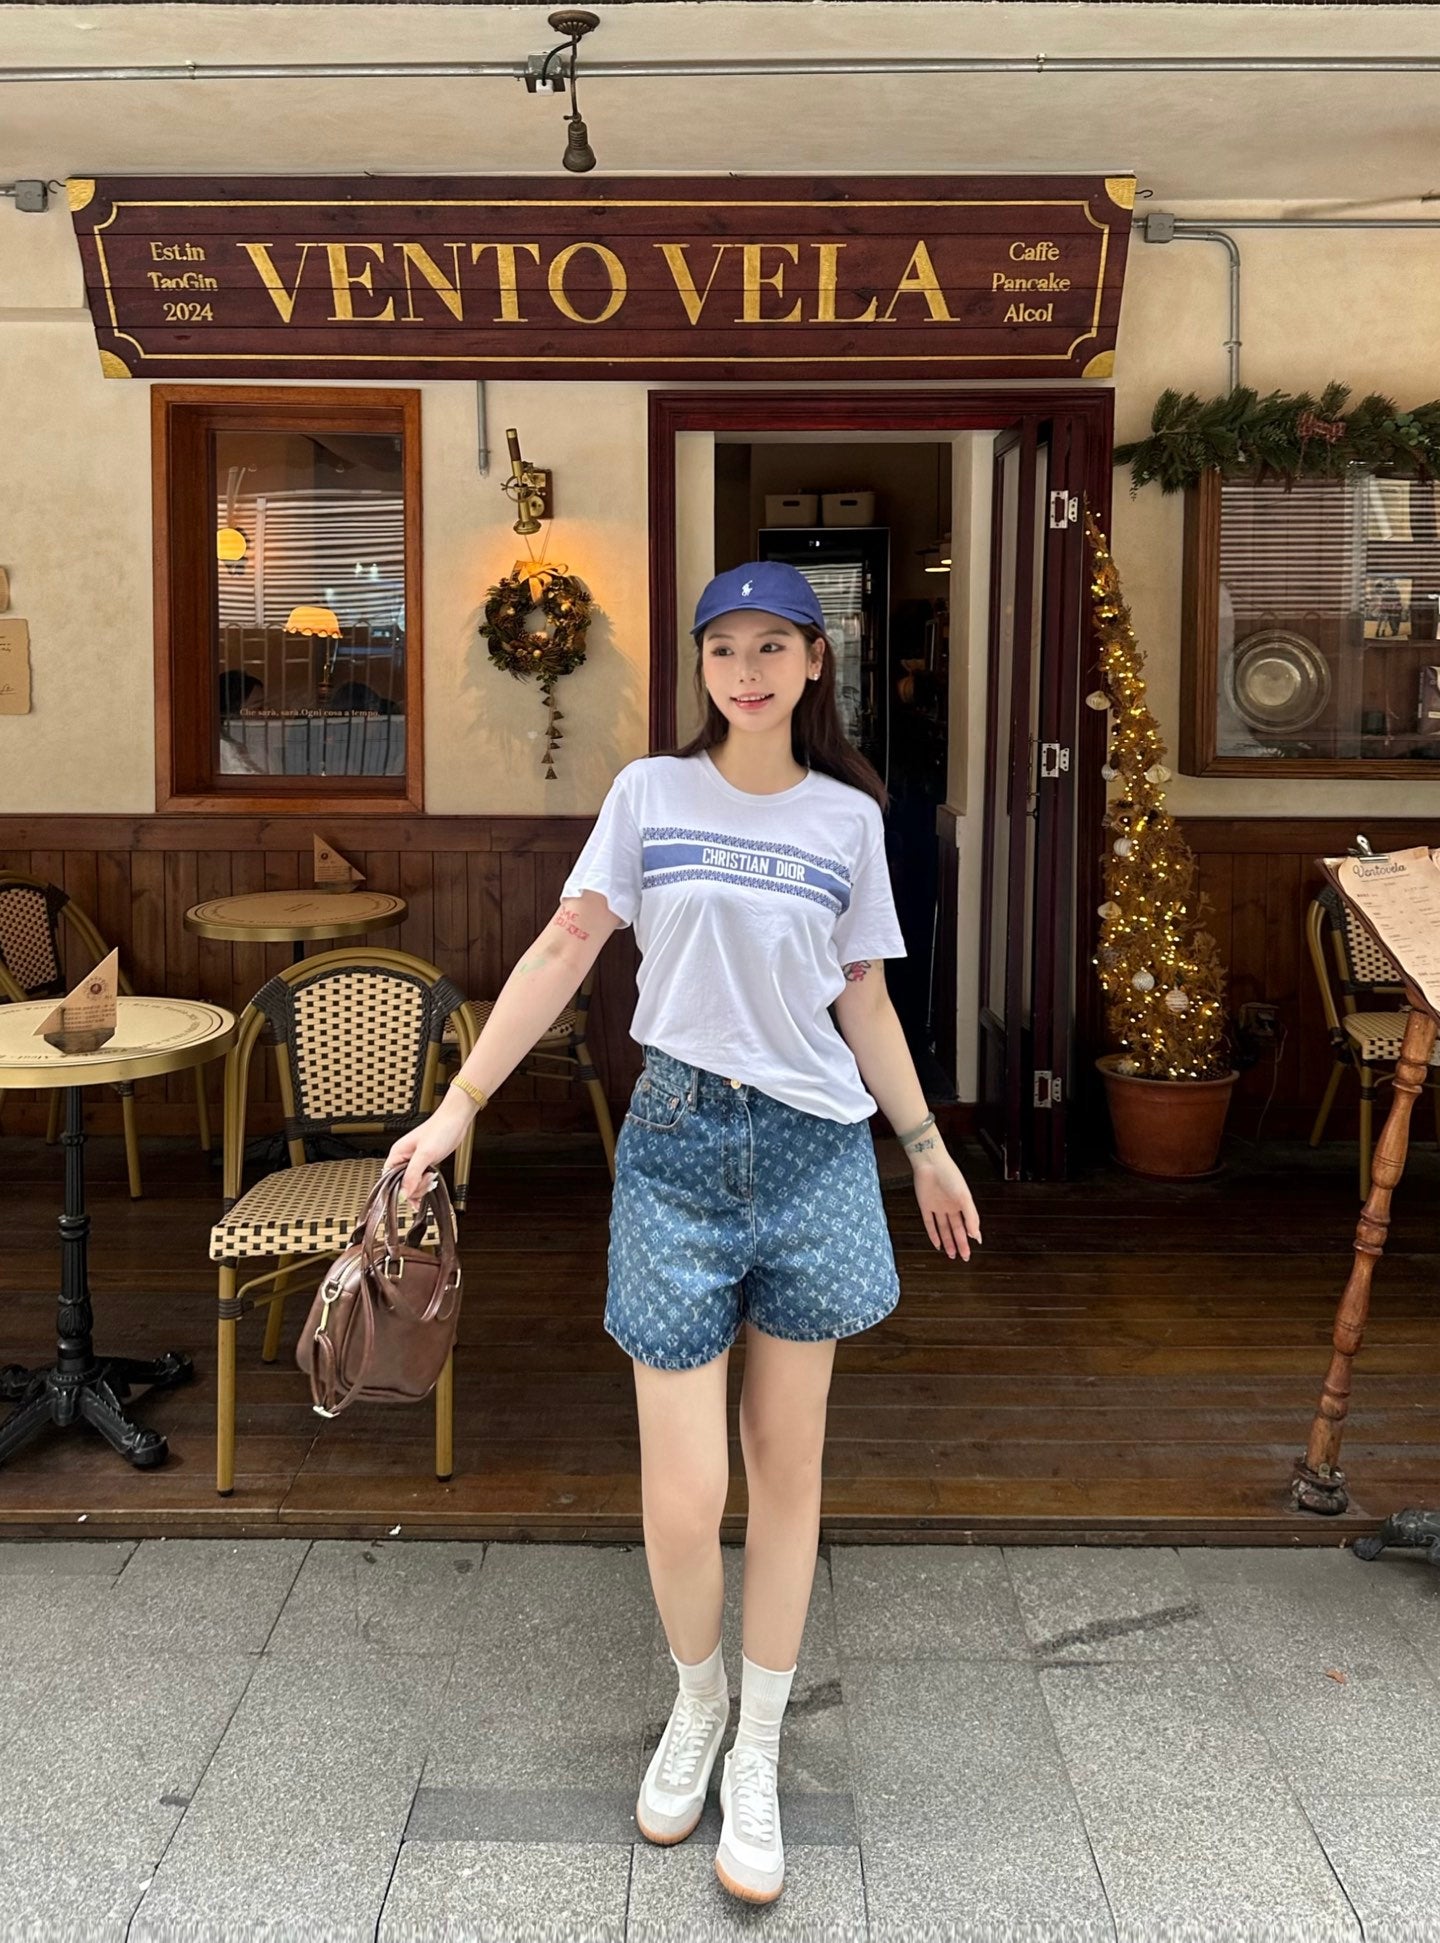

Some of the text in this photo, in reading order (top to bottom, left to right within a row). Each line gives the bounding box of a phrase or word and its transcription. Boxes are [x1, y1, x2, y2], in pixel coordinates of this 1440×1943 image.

[1009, 241, 1060, 261] Caffe
[236, 240, 960, 326] VENTO VELA
[991, 272, 1071, 292] Pancake
[163, 303, 213, 321] 2024
[1003, 303, 1053, 322] Alcol
[702, 847, 806, 881] CHRISTIAN DIOR
